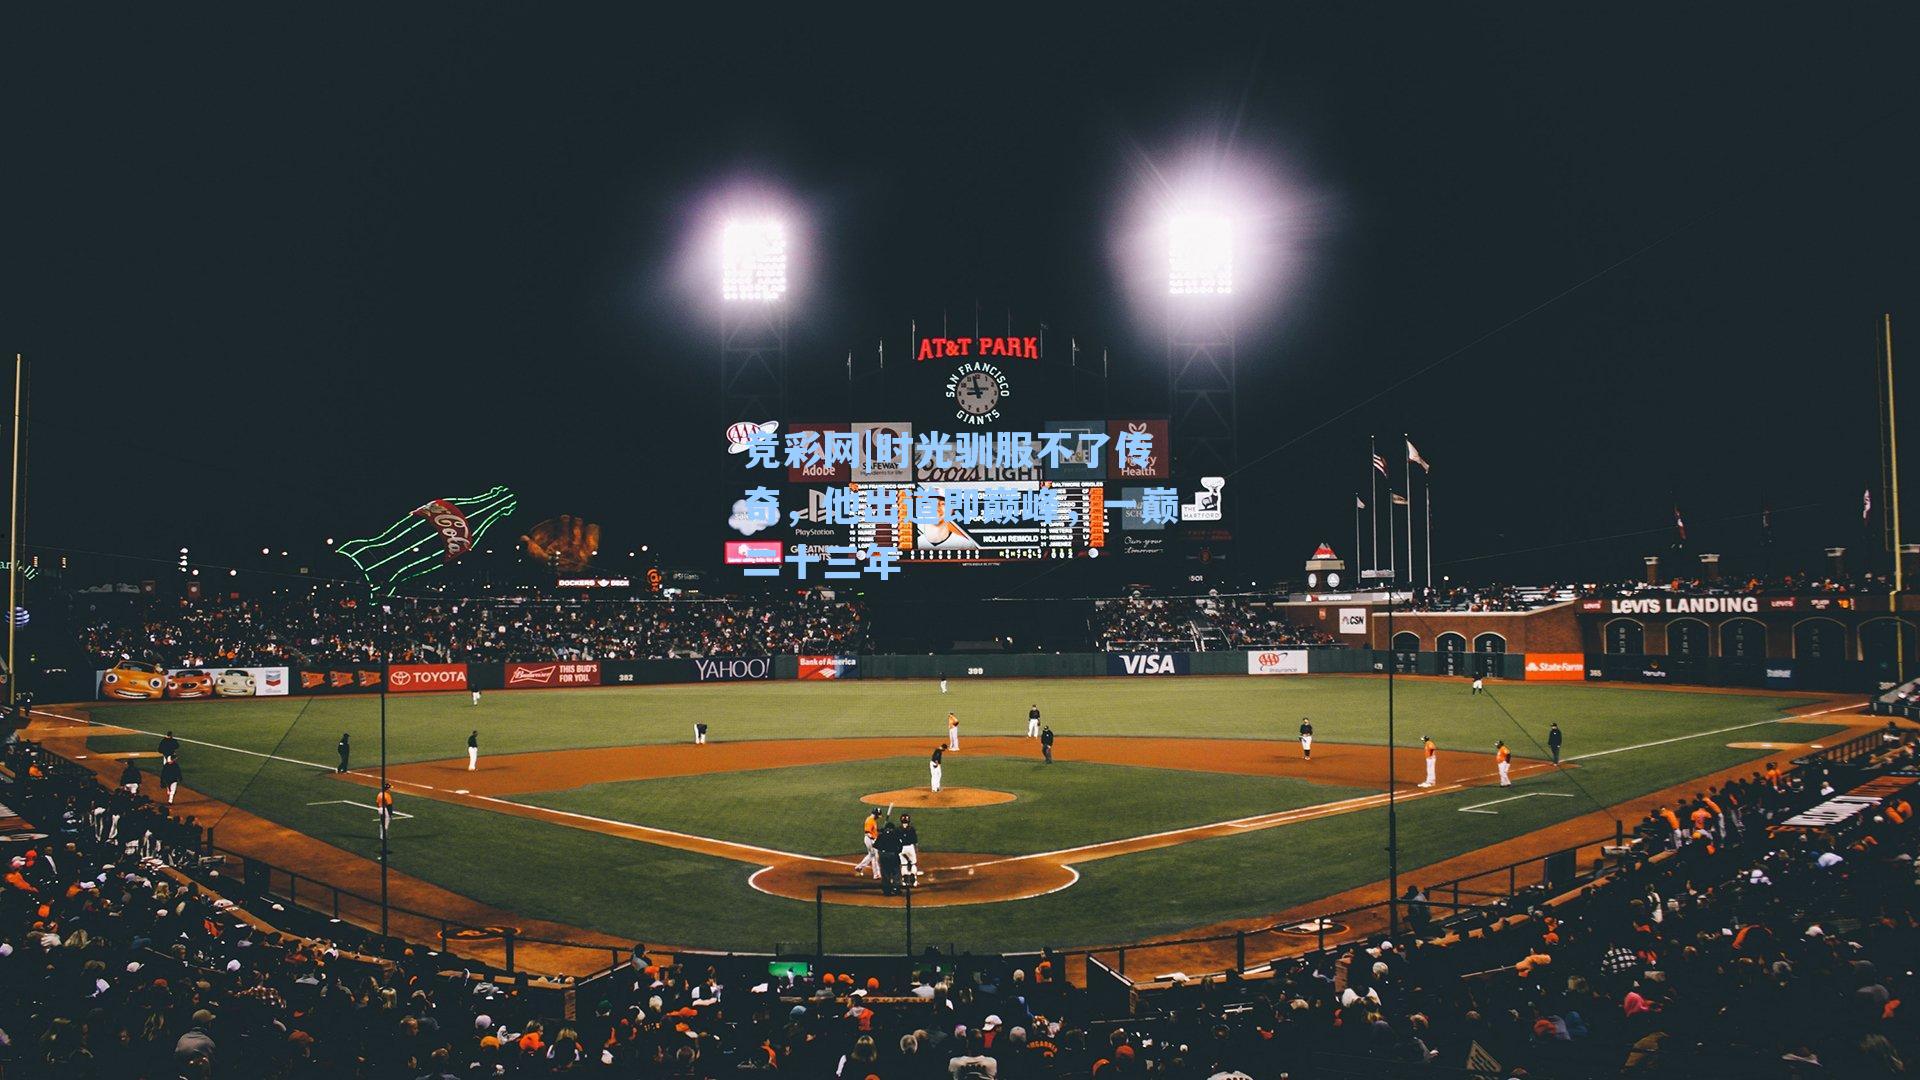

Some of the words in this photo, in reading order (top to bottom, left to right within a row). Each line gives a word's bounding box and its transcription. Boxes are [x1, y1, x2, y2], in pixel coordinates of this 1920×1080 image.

[918, 337, 972, 361] AT&T
[979, 336, 1039, 360] PARK
[945, 374, 960, 398] SAN
[958, 361, 1010, 397] FRANCISCO
[956, 409, 1001, 425] GIANTS
[802, 464, 836, 476] Adobe
[1121, 466, 1156, 476] Health
[795, 528, 835, 537] PlayStation
[983, 535, 1007, 543] NOLAN
[1008, 535, 1039, 543] REIMOLD
[1666, 597, 1759, 613] LANDING
[1350, 616, 1364, 624] CSN
[800, 658, 819, 666] Bank
[819, 658, 826, 666] of
[826, 658, 856, 666] America
[1119, 655, 1176, 674] VISA
[559, 665, 576, 673] THIS
[576, 665, 597, 673] BUD'S
[695, 658, 770, 681] YAHOO!
[413, 672, 467, 683] TOYOTA
[514, 671, 552, 679] Budweiser
[559, 674, 574, 682] FOR
[575, 674, 591, 682] YOU.
